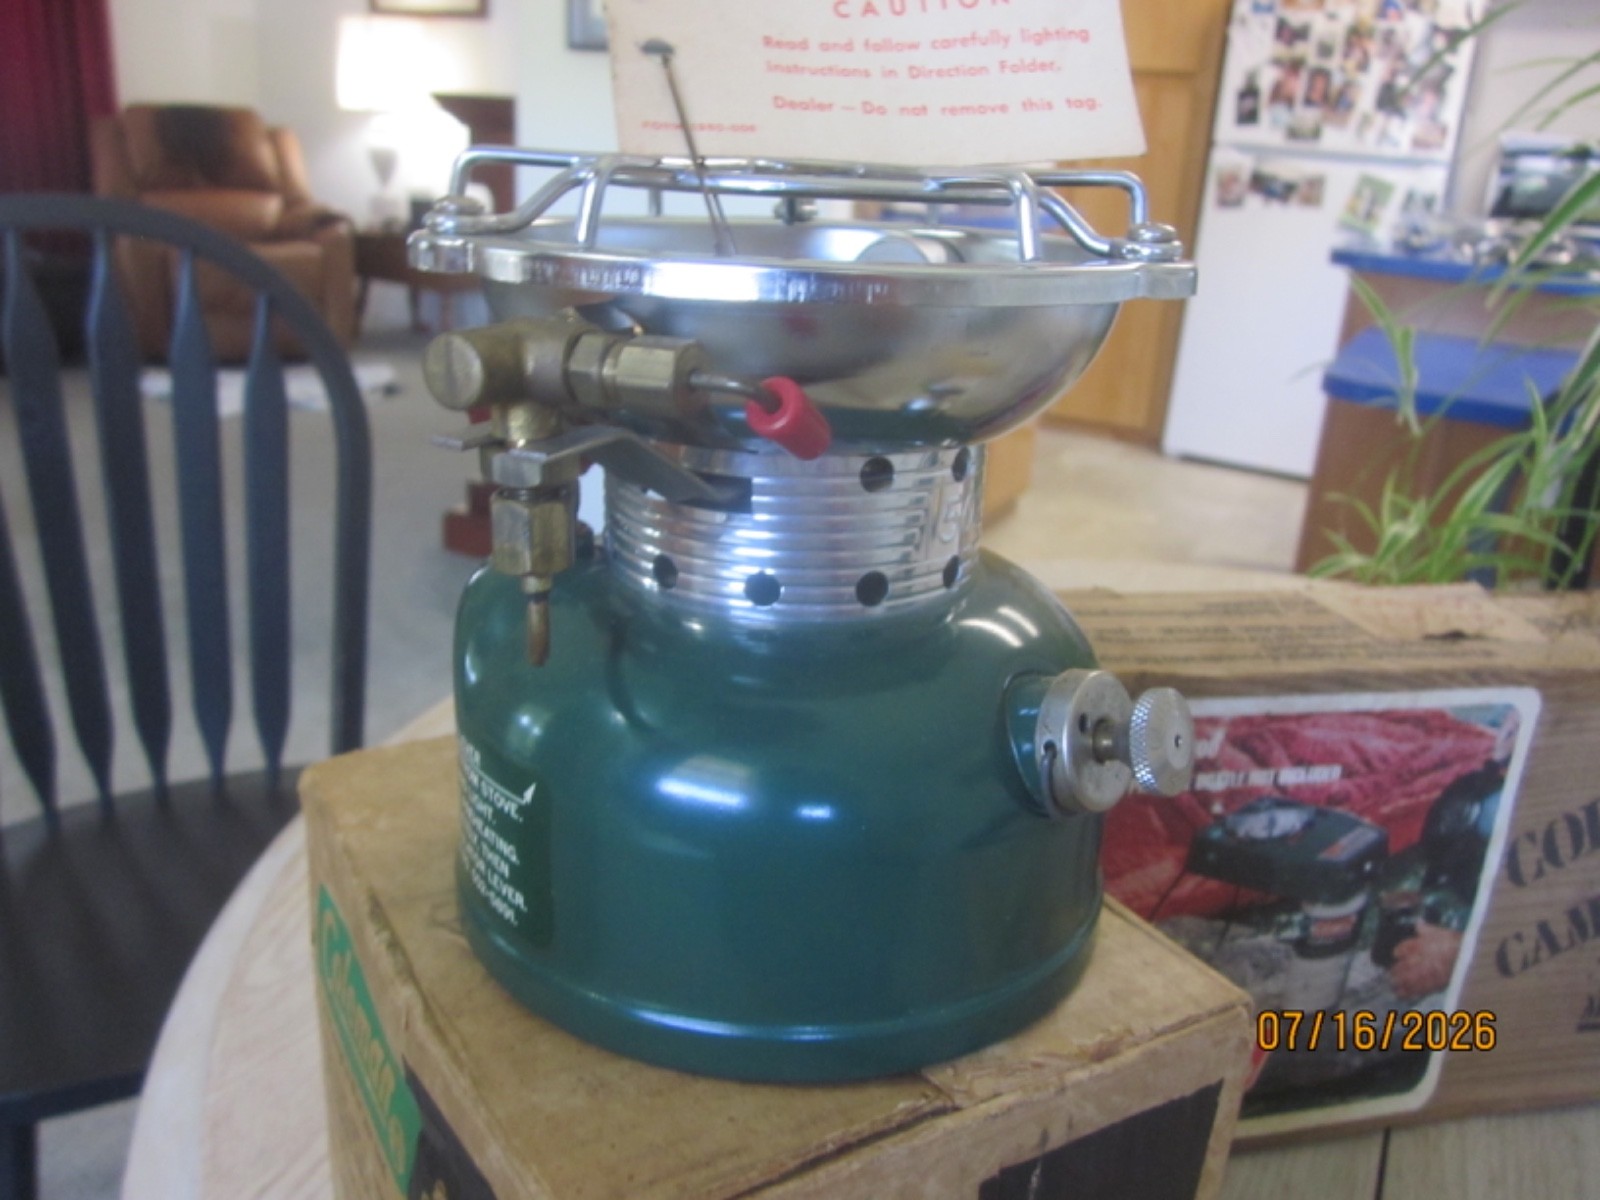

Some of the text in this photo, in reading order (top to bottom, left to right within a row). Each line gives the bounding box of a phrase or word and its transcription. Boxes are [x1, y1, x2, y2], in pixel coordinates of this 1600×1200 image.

[833, 0, 1010, 18] CAUT
[763, 27, 1089, 51] Read and follow carefully lighting
[881, 66, 898, 78] in
[908, 65, 989, 78] Direction
[999, 58, 1061, 73] Folder.
[773, 96, 833, 111] Dealer
[861, 101, 888, 115] Do
[899, 105, 928, 117] not
[941, 103, 1009, 116] remove
[1021, 98, 1053, 111] this
